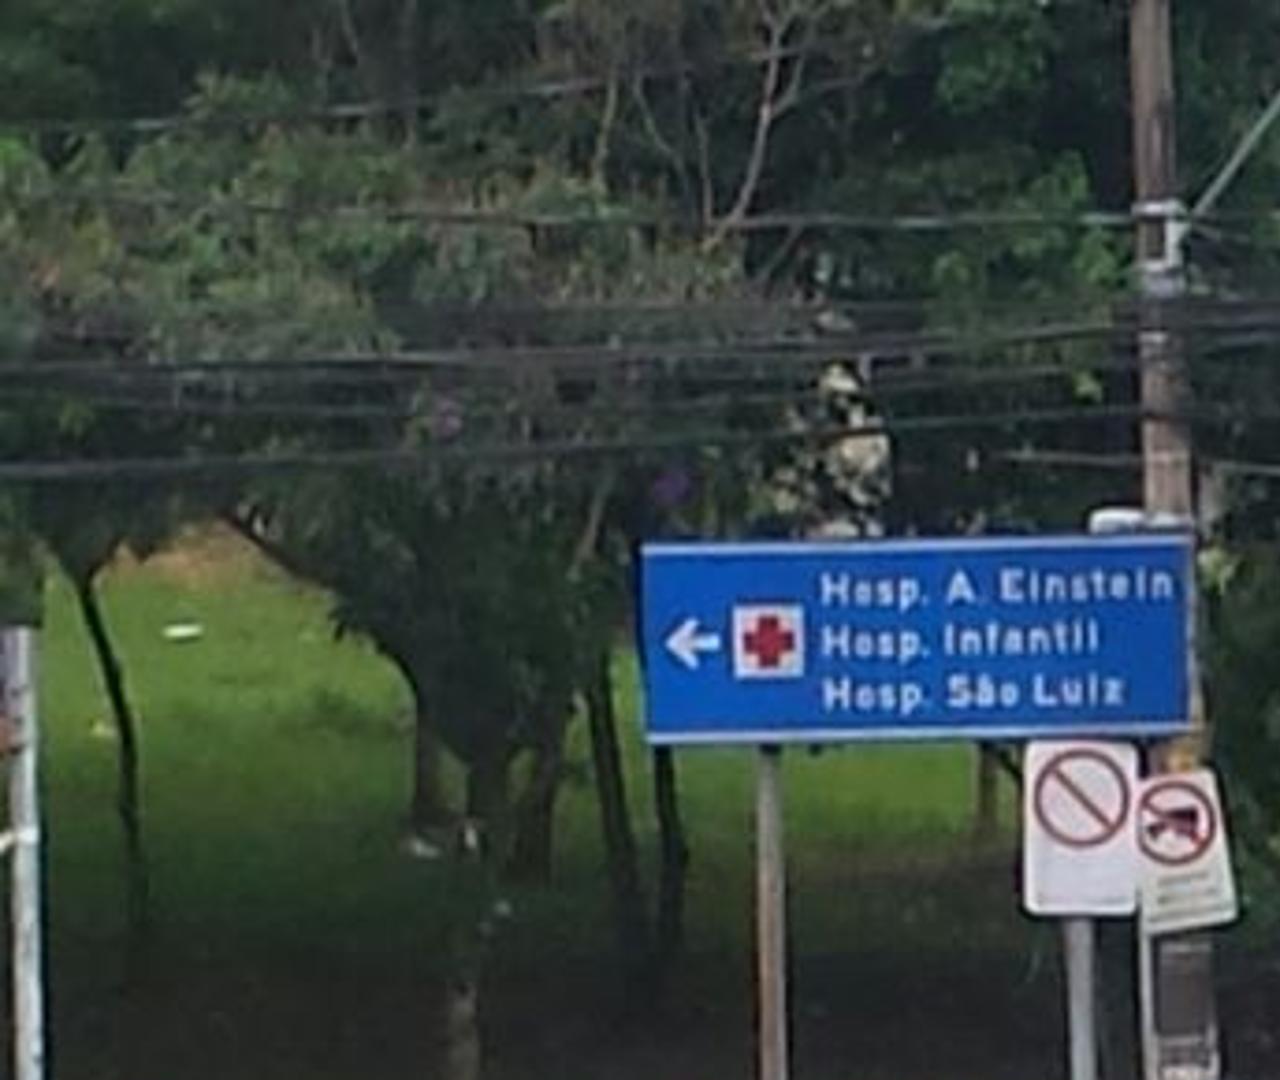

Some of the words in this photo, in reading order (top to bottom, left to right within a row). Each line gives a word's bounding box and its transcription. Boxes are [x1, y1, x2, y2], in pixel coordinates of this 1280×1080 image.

[821, 573, 928, 611] Hosp.
[1000, 567, 1174, 602] Einstein
[823, 623, 929, 665] Hosp.
[943, 618, 1099, 656] Infantil
[947, 672, 1021, 708] São
[1033, 671, 1125, 707] Luiz
